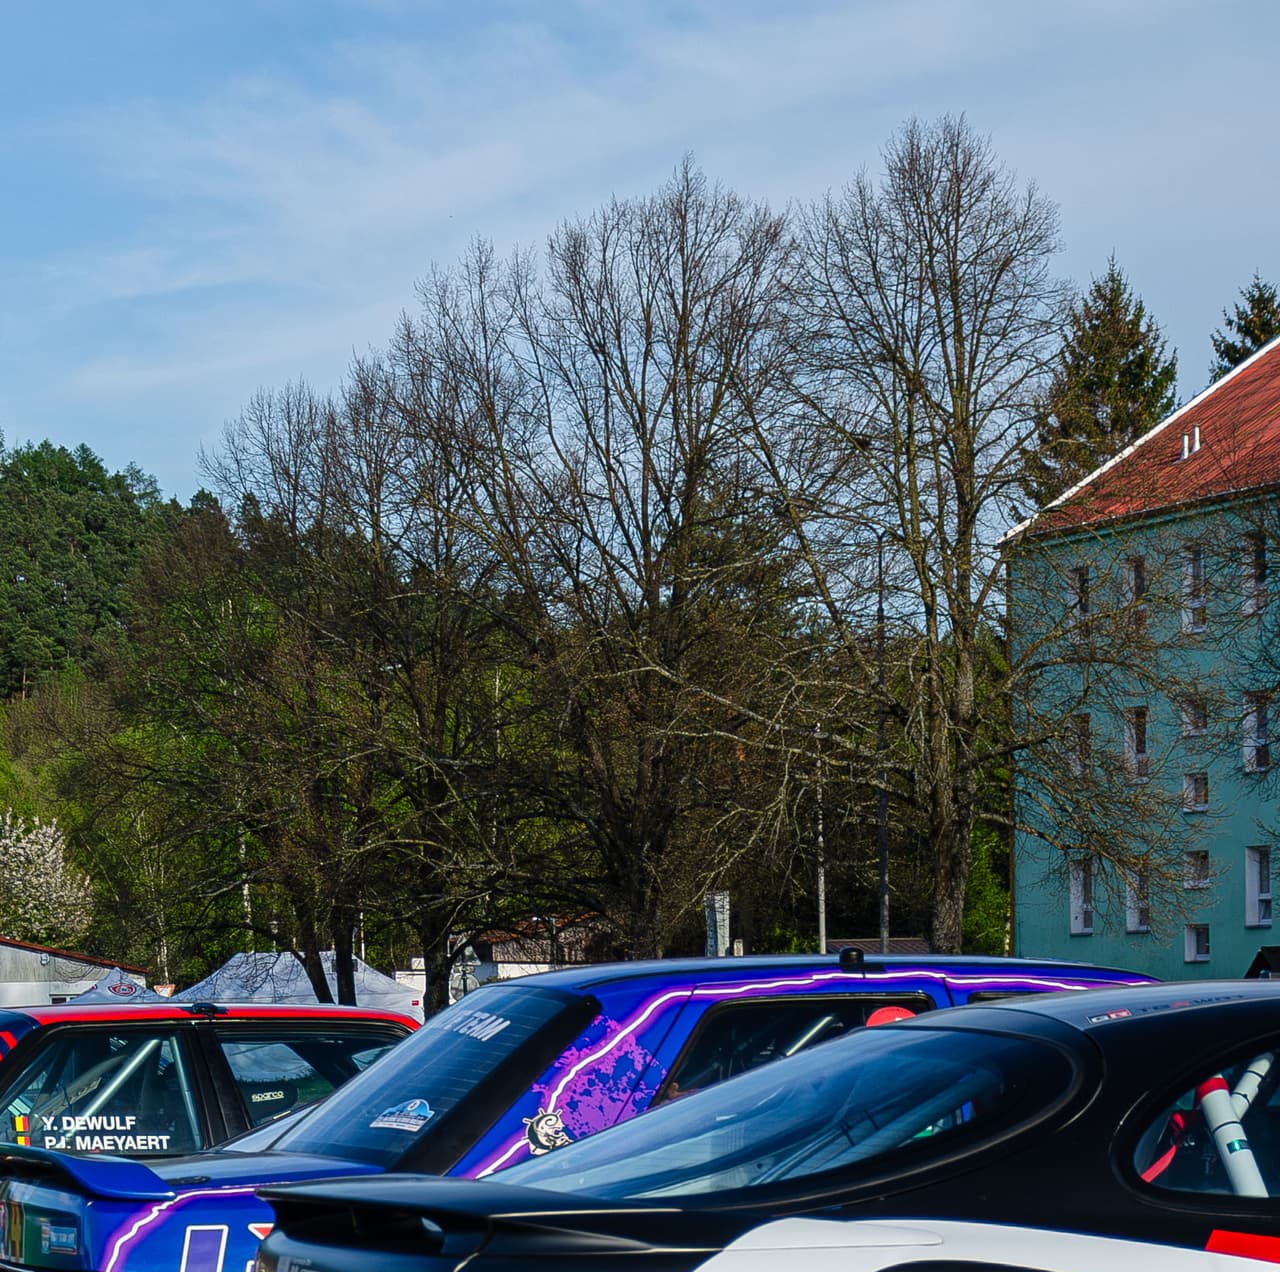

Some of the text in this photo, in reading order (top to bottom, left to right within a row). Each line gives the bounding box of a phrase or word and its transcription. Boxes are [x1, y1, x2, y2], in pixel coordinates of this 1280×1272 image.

[42, 1115, 137, 1131] Y. DEWULF
[76, 1135, 171, 1151] MAEYAERT
